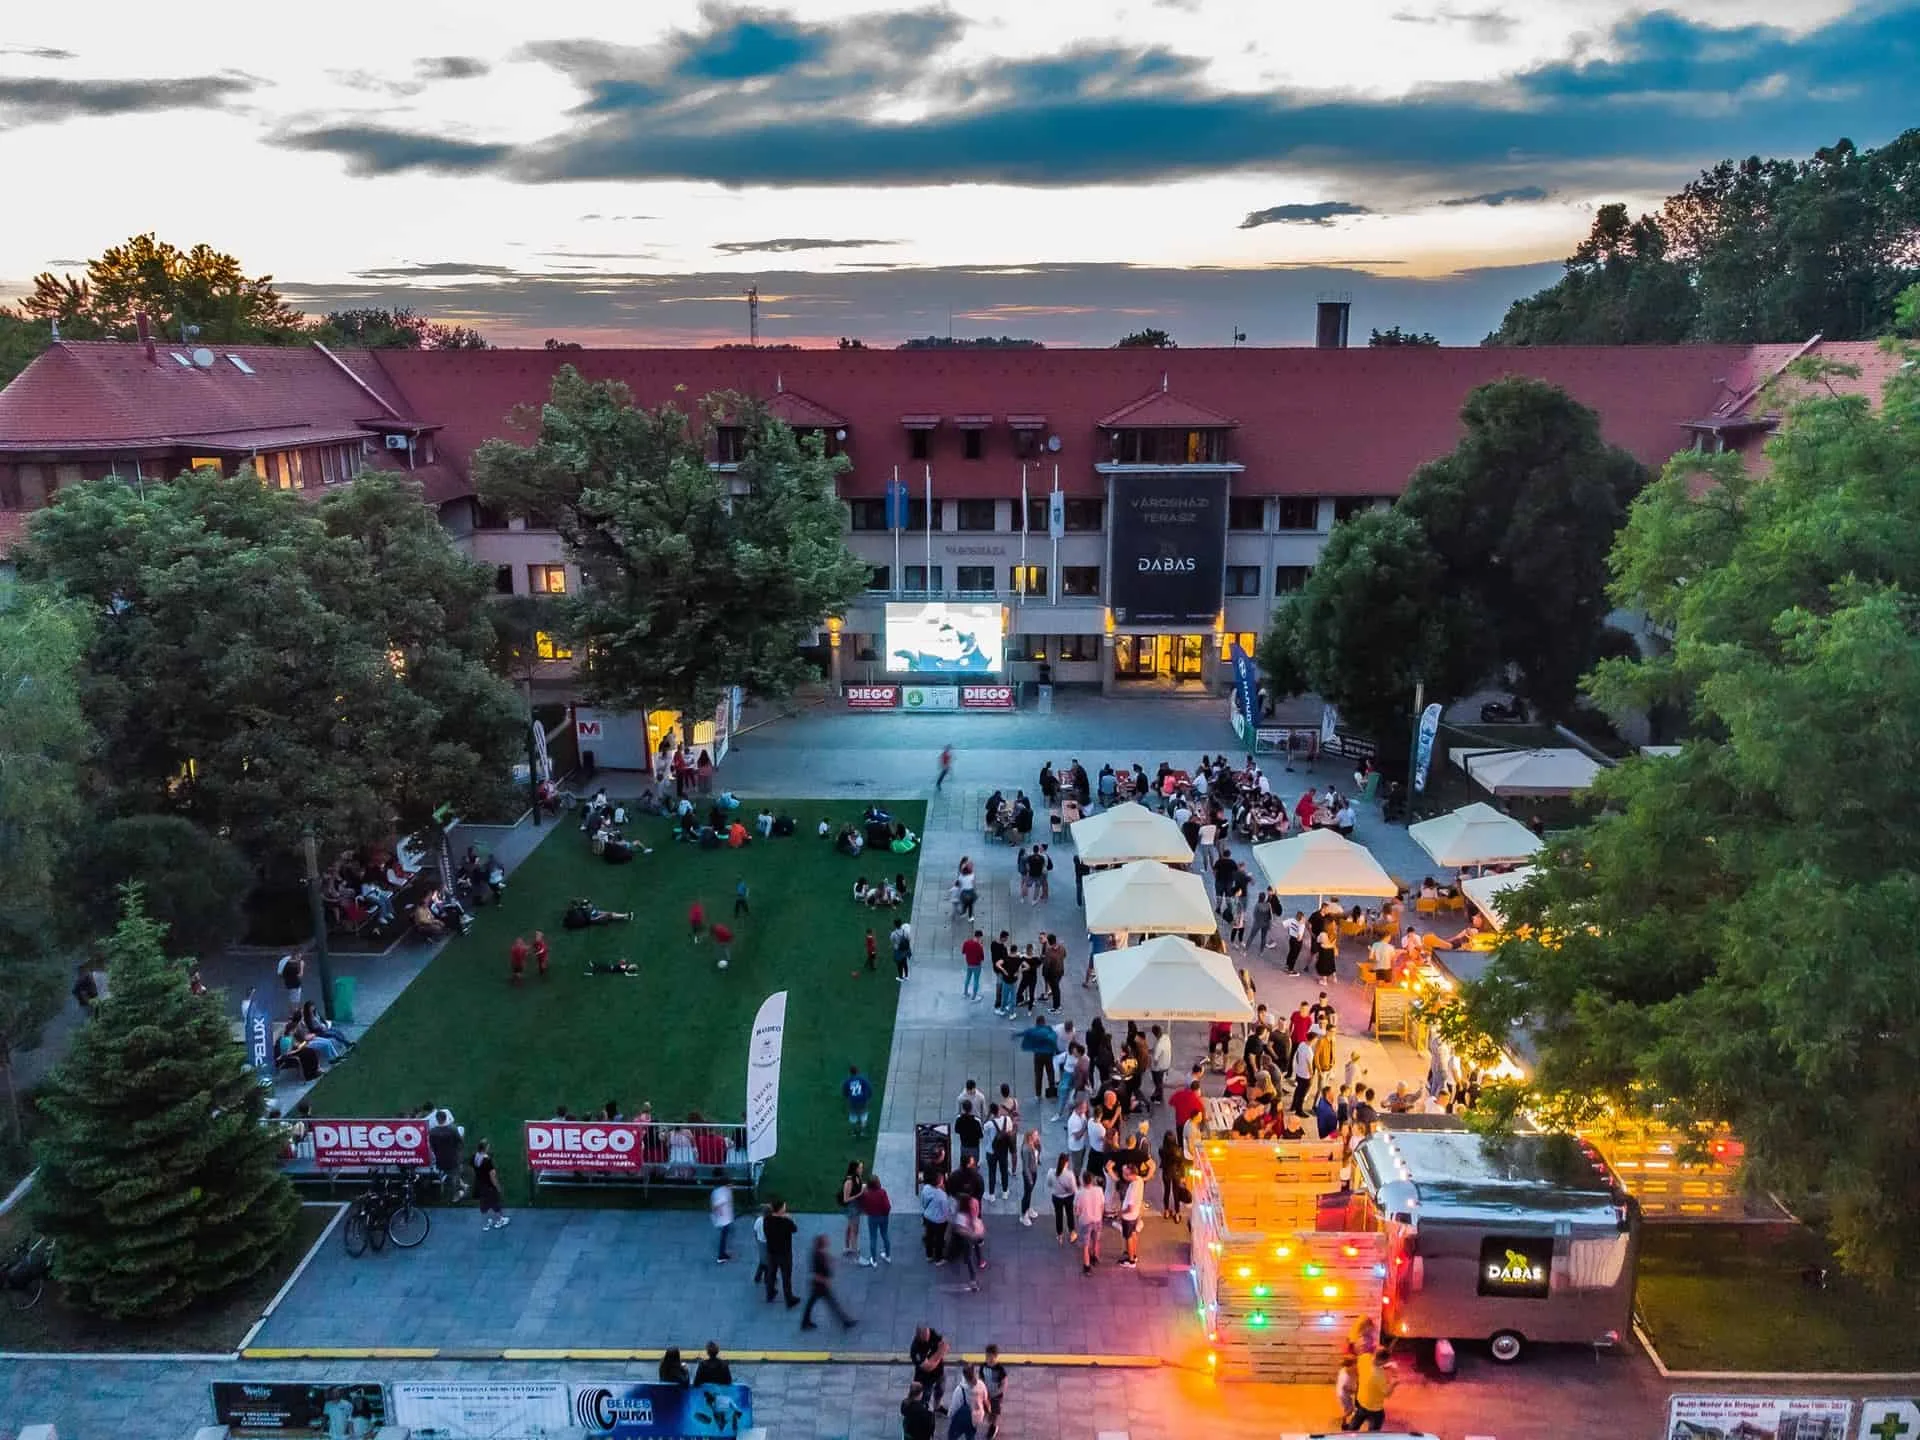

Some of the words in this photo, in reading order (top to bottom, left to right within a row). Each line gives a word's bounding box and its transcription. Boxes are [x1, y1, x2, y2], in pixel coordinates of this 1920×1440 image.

[1138, 558, 1196, 571] DABAS
[848, 688, 894, 699] DIEGO
[963, 688, 1009, 699] DIEGO
[314, 1126, 422, 1149] DIEGO
[528, 1128, 635, 1152] DIEGO
[1488, 1265, 1541, 1280] DABAS
